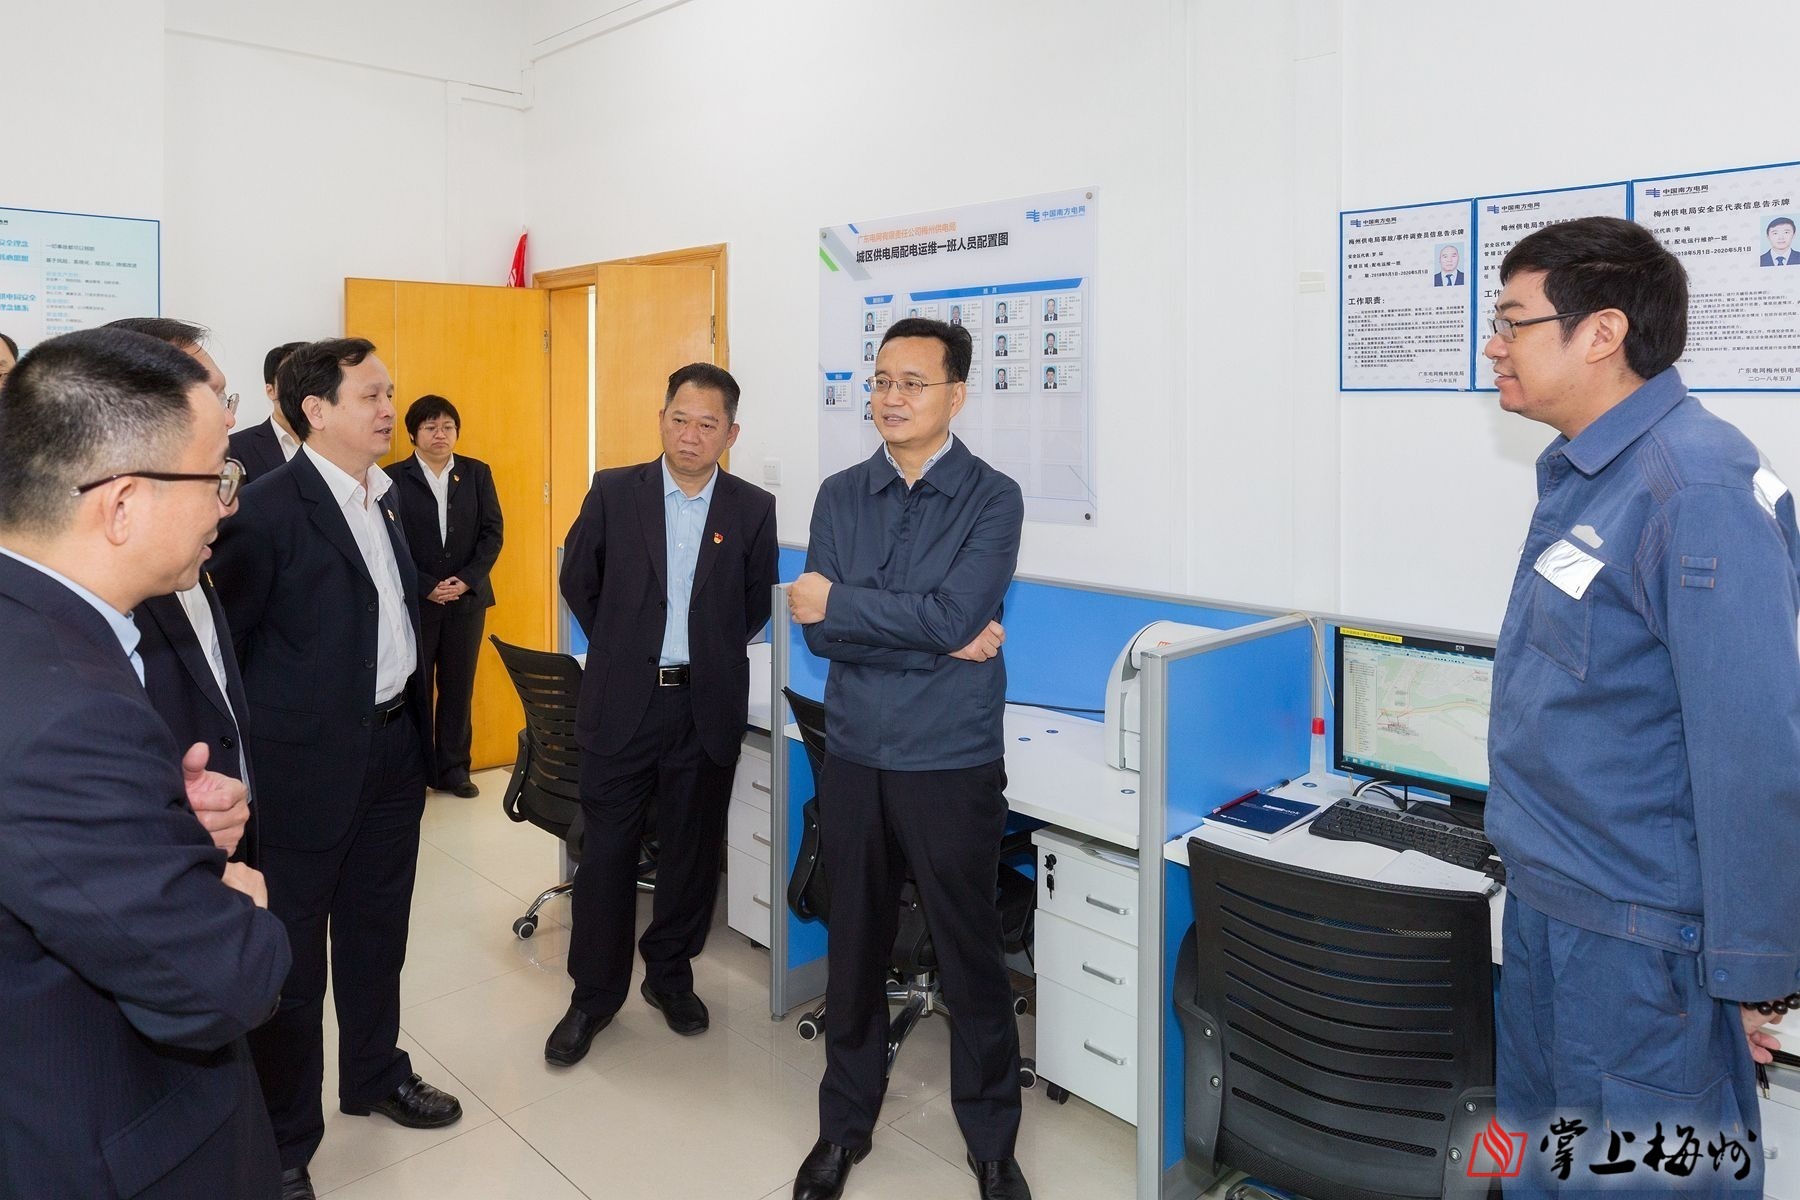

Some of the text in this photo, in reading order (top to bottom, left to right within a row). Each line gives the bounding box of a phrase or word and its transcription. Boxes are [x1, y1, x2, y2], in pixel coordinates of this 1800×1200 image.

[1662, 184, 1709, 194] 中国南方电网
[1501, 202, 1540, 211] 中国南方电网
[1653, 198, 1791, 218] 梅州供电局安全区代表信息告示牌
[1041, 205, 1086, 219] 中国南方电网
[1362, 216, 1397, 226] 中国南方电网
[855, 232, 1009, 264] 城区供电局配电运维一班人员配置图
[1347, 296, 1385, 306] 工作职责:
